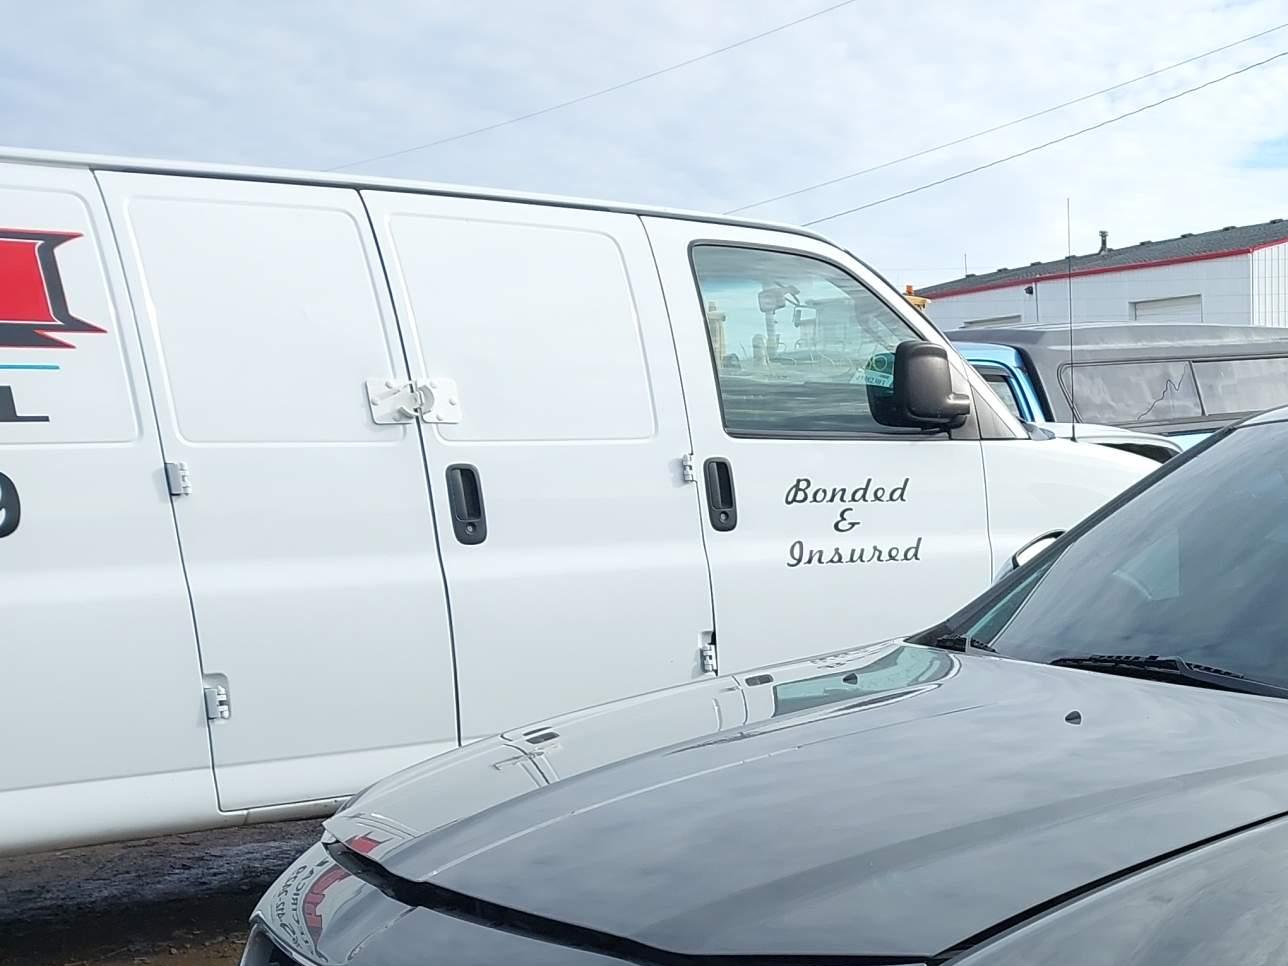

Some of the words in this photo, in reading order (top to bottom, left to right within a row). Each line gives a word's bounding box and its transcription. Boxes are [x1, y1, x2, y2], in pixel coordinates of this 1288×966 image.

[784, 477, 910, 505] Bonded
[833, 507, 861, 533] &
[786, 536, 923, 568] Insured
